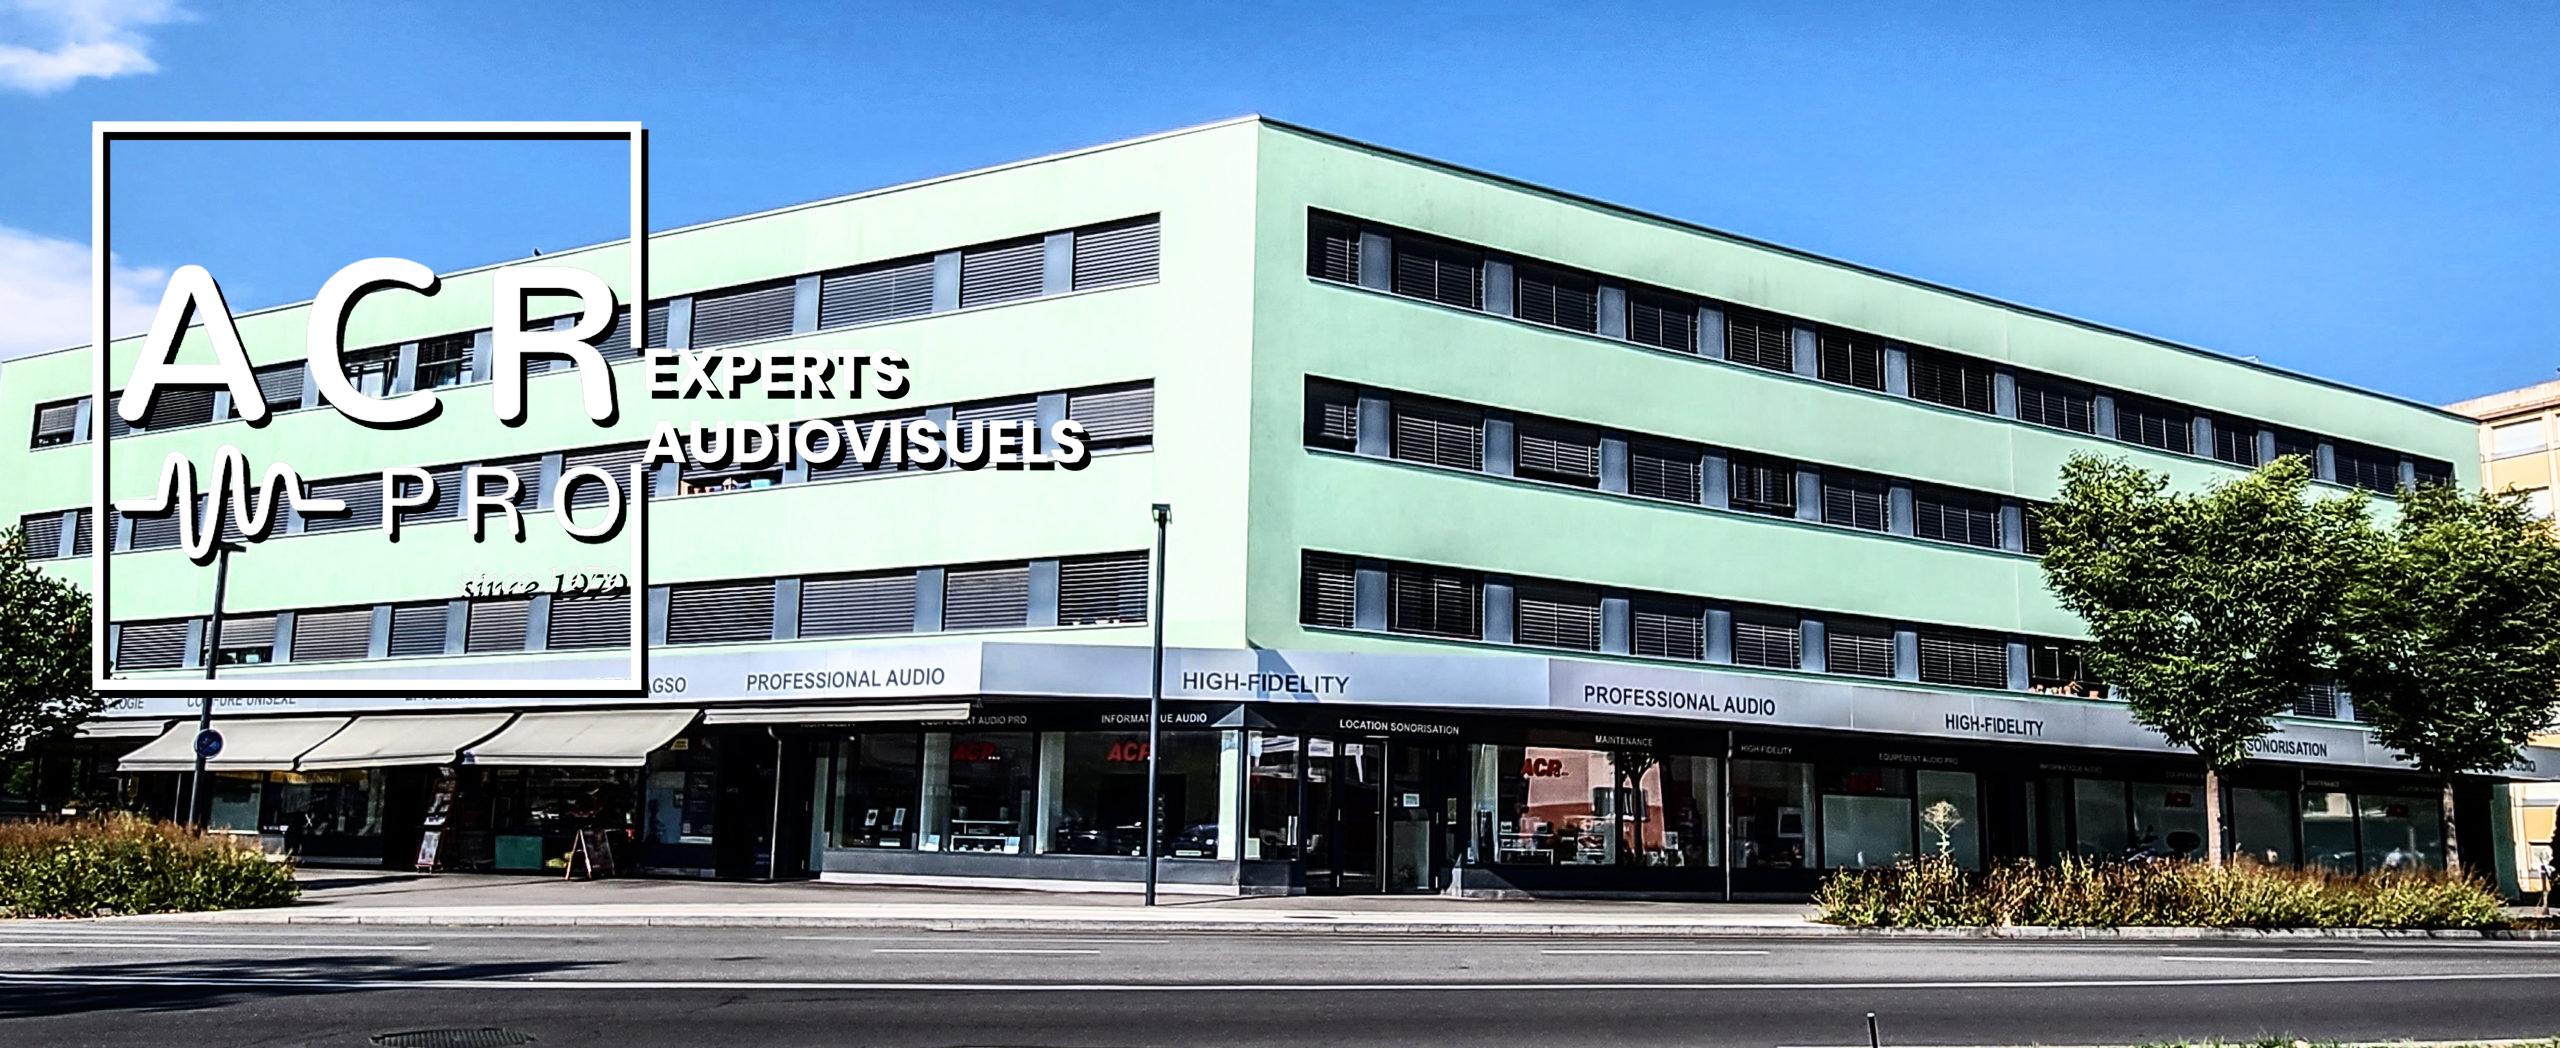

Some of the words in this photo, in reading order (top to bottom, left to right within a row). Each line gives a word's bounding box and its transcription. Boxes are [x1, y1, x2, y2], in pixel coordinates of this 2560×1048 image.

[746, 670, 882, 691] PROFESSIONAL
[885, 667, 945, 687] AUDIO
[1182, 671, 1350, 694] HIGH-FIDELITY
[1584, 685, 1721, 712] PROFESSIONAL
[1723, 696, 1776, 716] AUDIO
[978, 716, 1006, 725] AUDIO
[1007, 715, 1028, 725] PRO
[1101, 713, 1173, 724] INFORMATUE
[1175, 713, 1208, 723] AUDIO
[1339, 719, 1389, 731] LOCATION
[1390, 722, 1460, 735] SONORISATION
[1945, 713, 2044, 736] HIGH-FIDELITY
[1594, 735, 1653, 747] MAINTENANCE
[2246, 737, 2328, 757] SONORISATION
